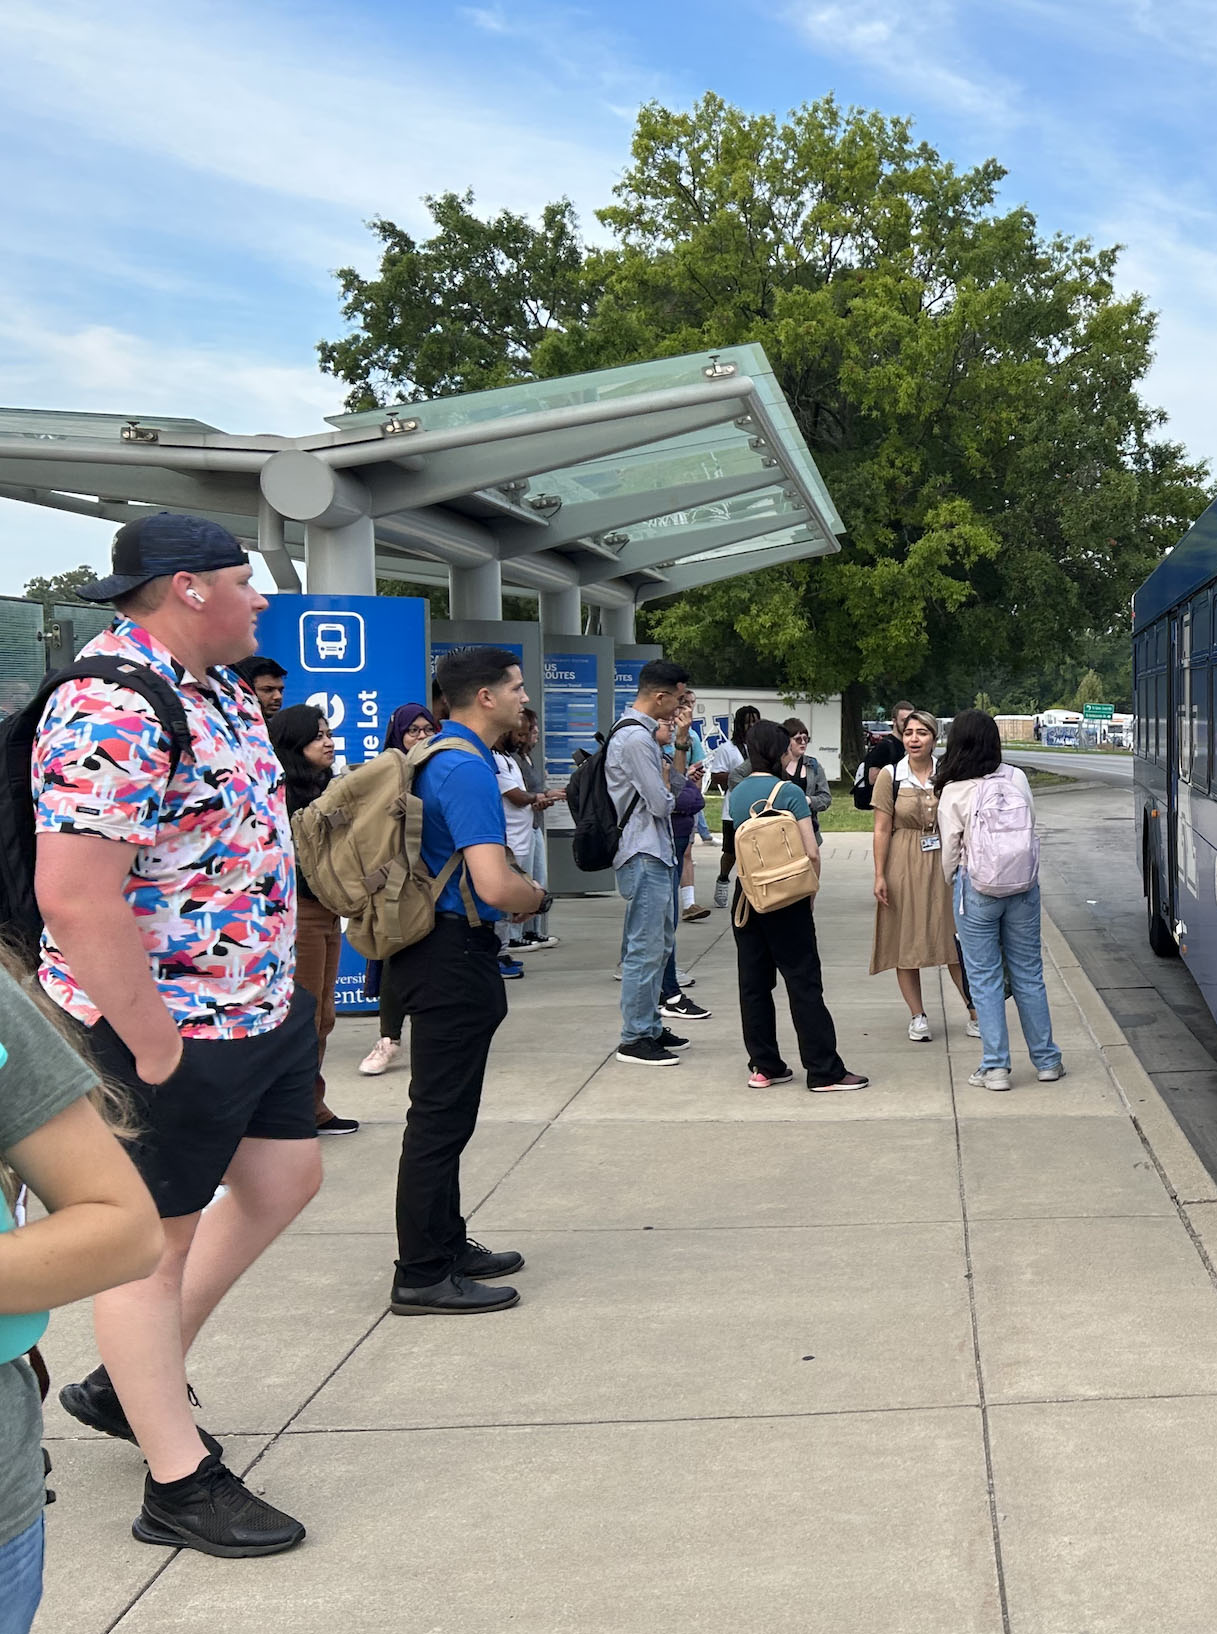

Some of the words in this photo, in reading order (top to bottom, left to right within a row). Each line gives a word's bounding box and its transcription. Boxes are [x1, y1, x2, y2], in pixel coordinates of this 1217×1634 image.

[544, 663, 557, 672] US
[614, 674, 633, 682] UTES
[357, 690, 378, 728] Lot
[363, 735, 379, 763] ue
[334, 972, 366, 985] versit
